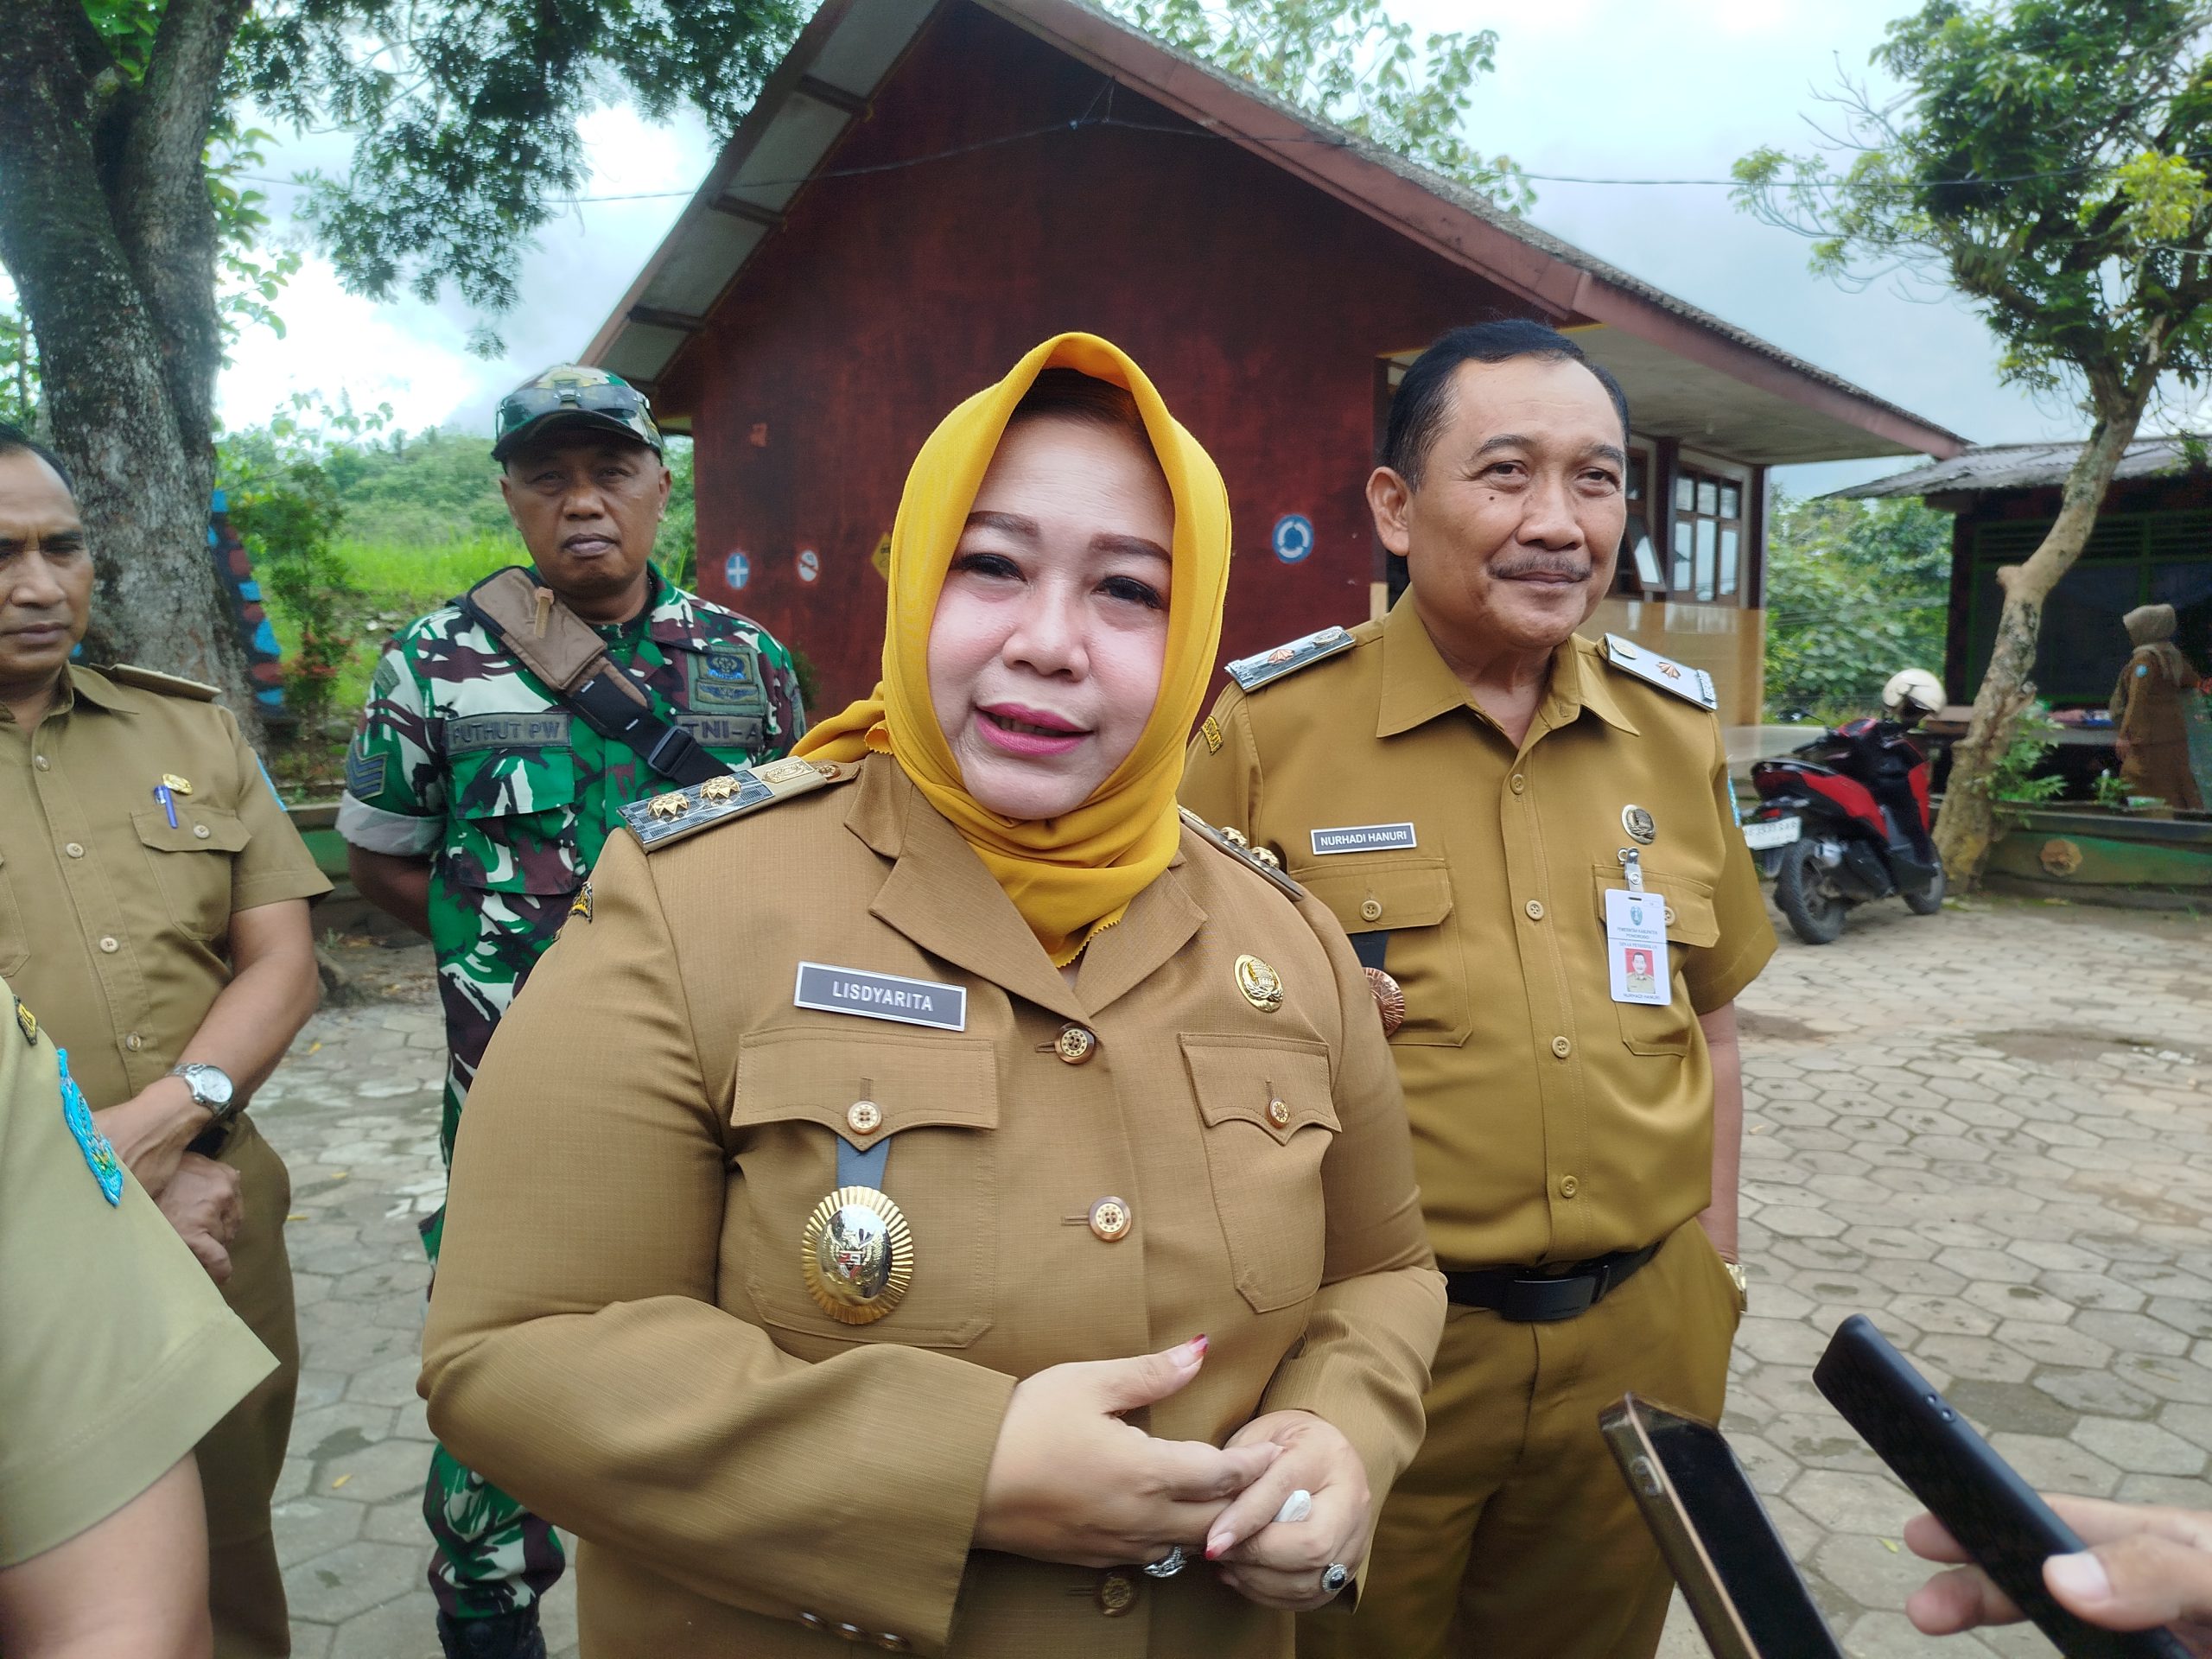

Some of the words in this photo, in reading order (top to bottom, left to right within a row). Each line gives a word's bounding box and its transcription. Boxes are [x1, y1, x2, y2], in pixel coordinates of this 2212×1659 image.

[529, 721, 560, 740] PW
[1320, 834, 1366, 846] NURHADI
[1368, 830, 1408, 842] HANURI
[832, 981, 934, 1012] LISDYARITA
